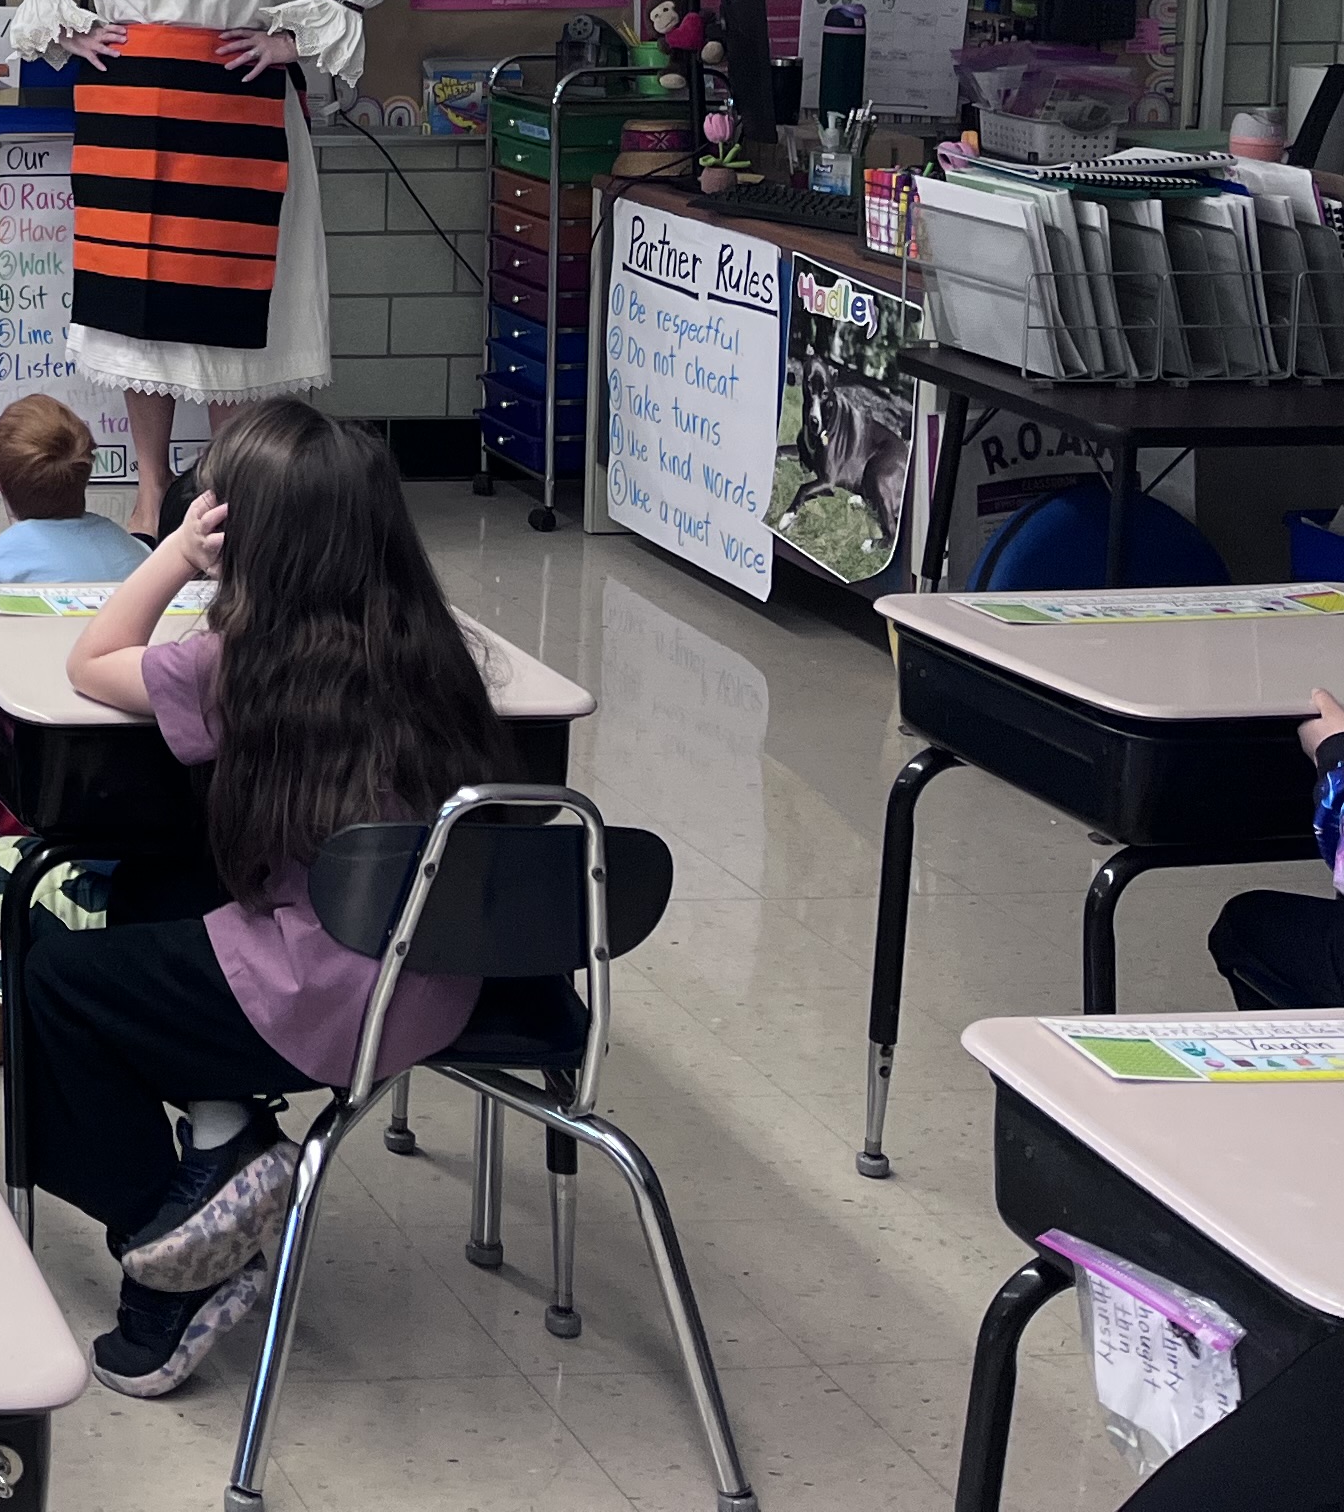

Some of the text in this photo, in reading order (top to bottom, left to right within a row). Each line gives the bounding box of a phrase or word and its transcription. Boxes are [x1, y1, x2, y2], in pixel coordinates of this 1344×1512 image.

[6, 146, 50, 171] Our
[20, 221, 66, 243] Have
[19, 251, 64, 276] Walk
[629, 216, 773, 303] Partner Rules
[18, 285, 46, 309] Sit
[629, 290, 646, 323] Be
[798, 272, 878, 339] Hadley
[18, 319, 53, 345] Line
[15, 354, 76, 381] Listen
[628, 337, 645, 367] Do
[654, 345, 676, 377] not
[626, 385, 661, 423] Take
[627, 430, 648, 462] Use
[659, 438, 692, 483] kind
[660, 501, 668, 524] a
[674, 508, 711, 546] quiet
[720, 530, 766, 573] voice
[1234, 1039, 1335, 1054] Vaughn
[1090, 1279, 1116, 1366] thirsty
[1114, 1302, 1133, 1354] thin
